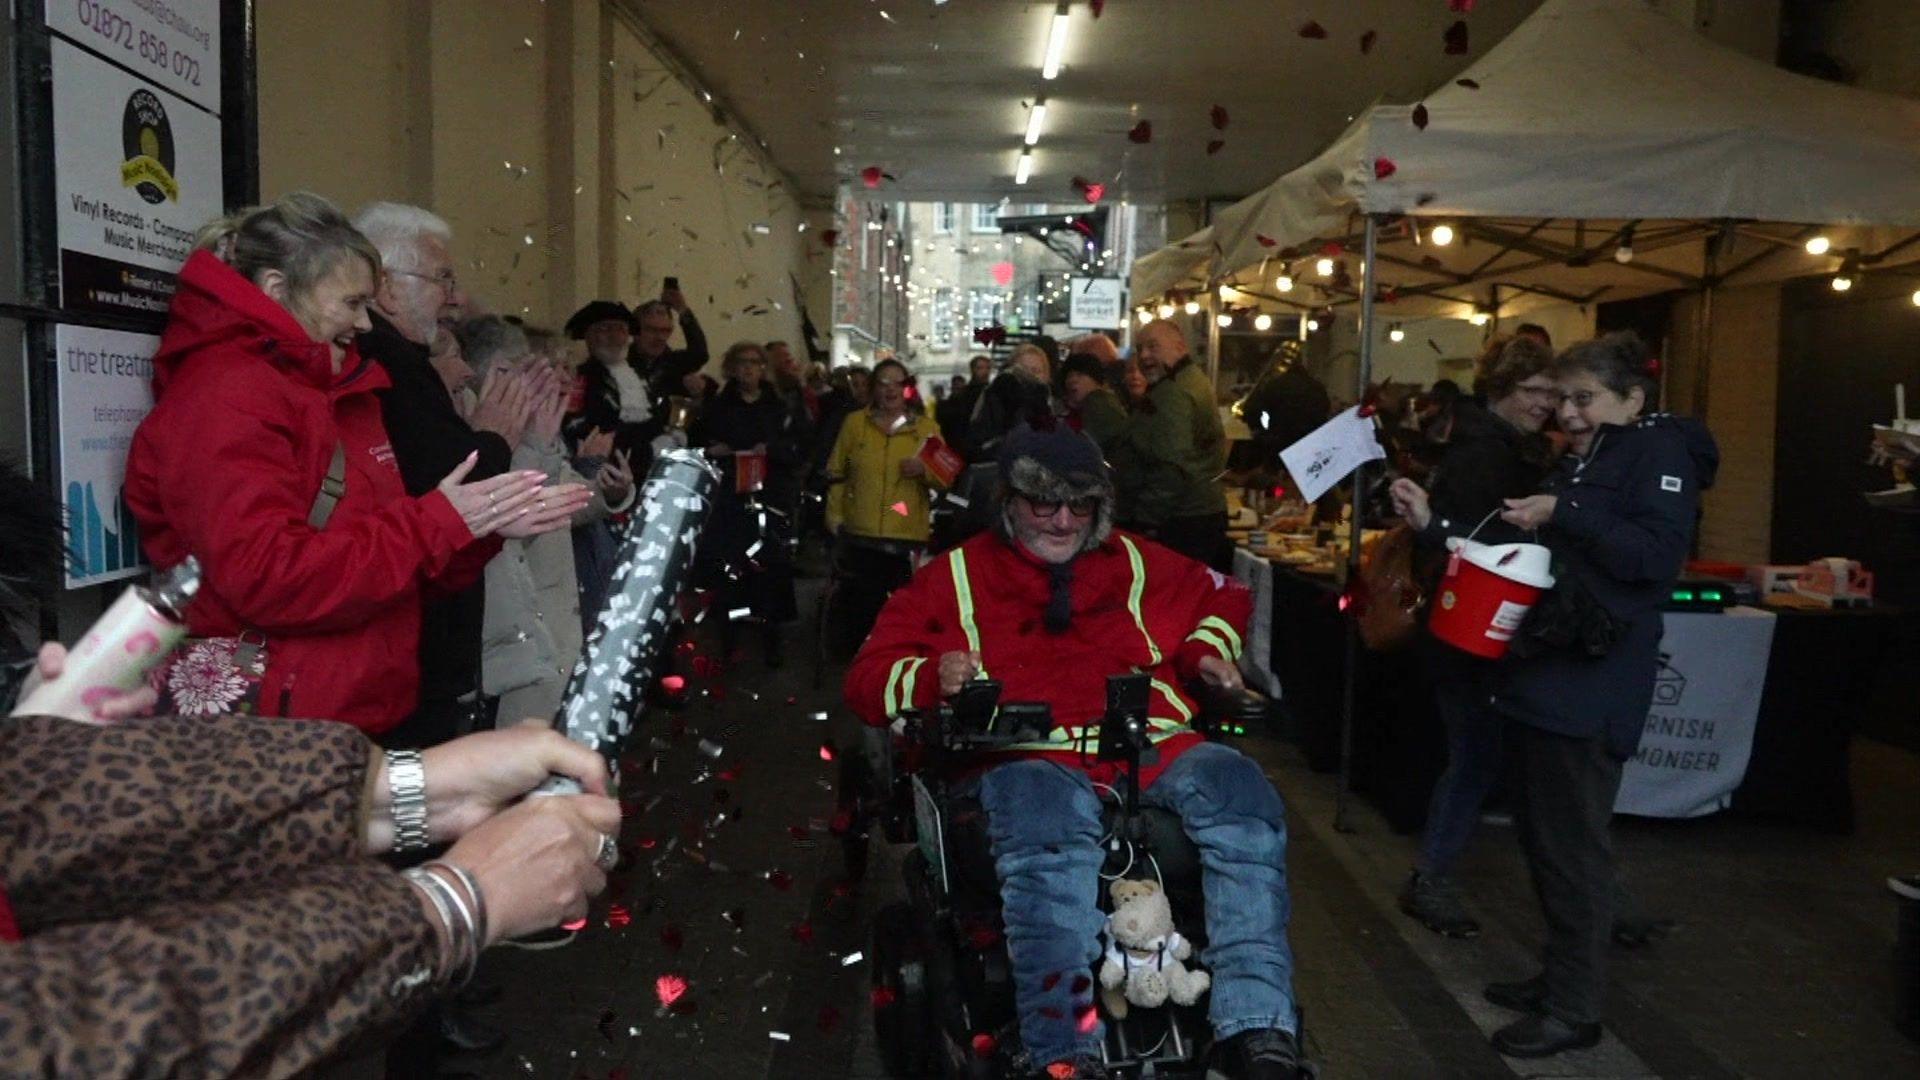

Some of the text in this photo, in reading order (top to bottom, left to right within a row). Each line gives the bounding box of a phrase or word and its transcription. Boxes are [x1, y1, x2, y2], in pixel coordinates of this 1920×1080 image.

[78, 0, 134, 50] 01872
[139, 29, 168, 69] 858
[173, 51, 201, 87] 072
[71, 193, 100, 221] Vinyl
[103, 203, 144, 230] Records
[104, 227, 134, 250] Music
[67, 346, 98, 375] the
[1646, 714, 1714, 739] RNISH
